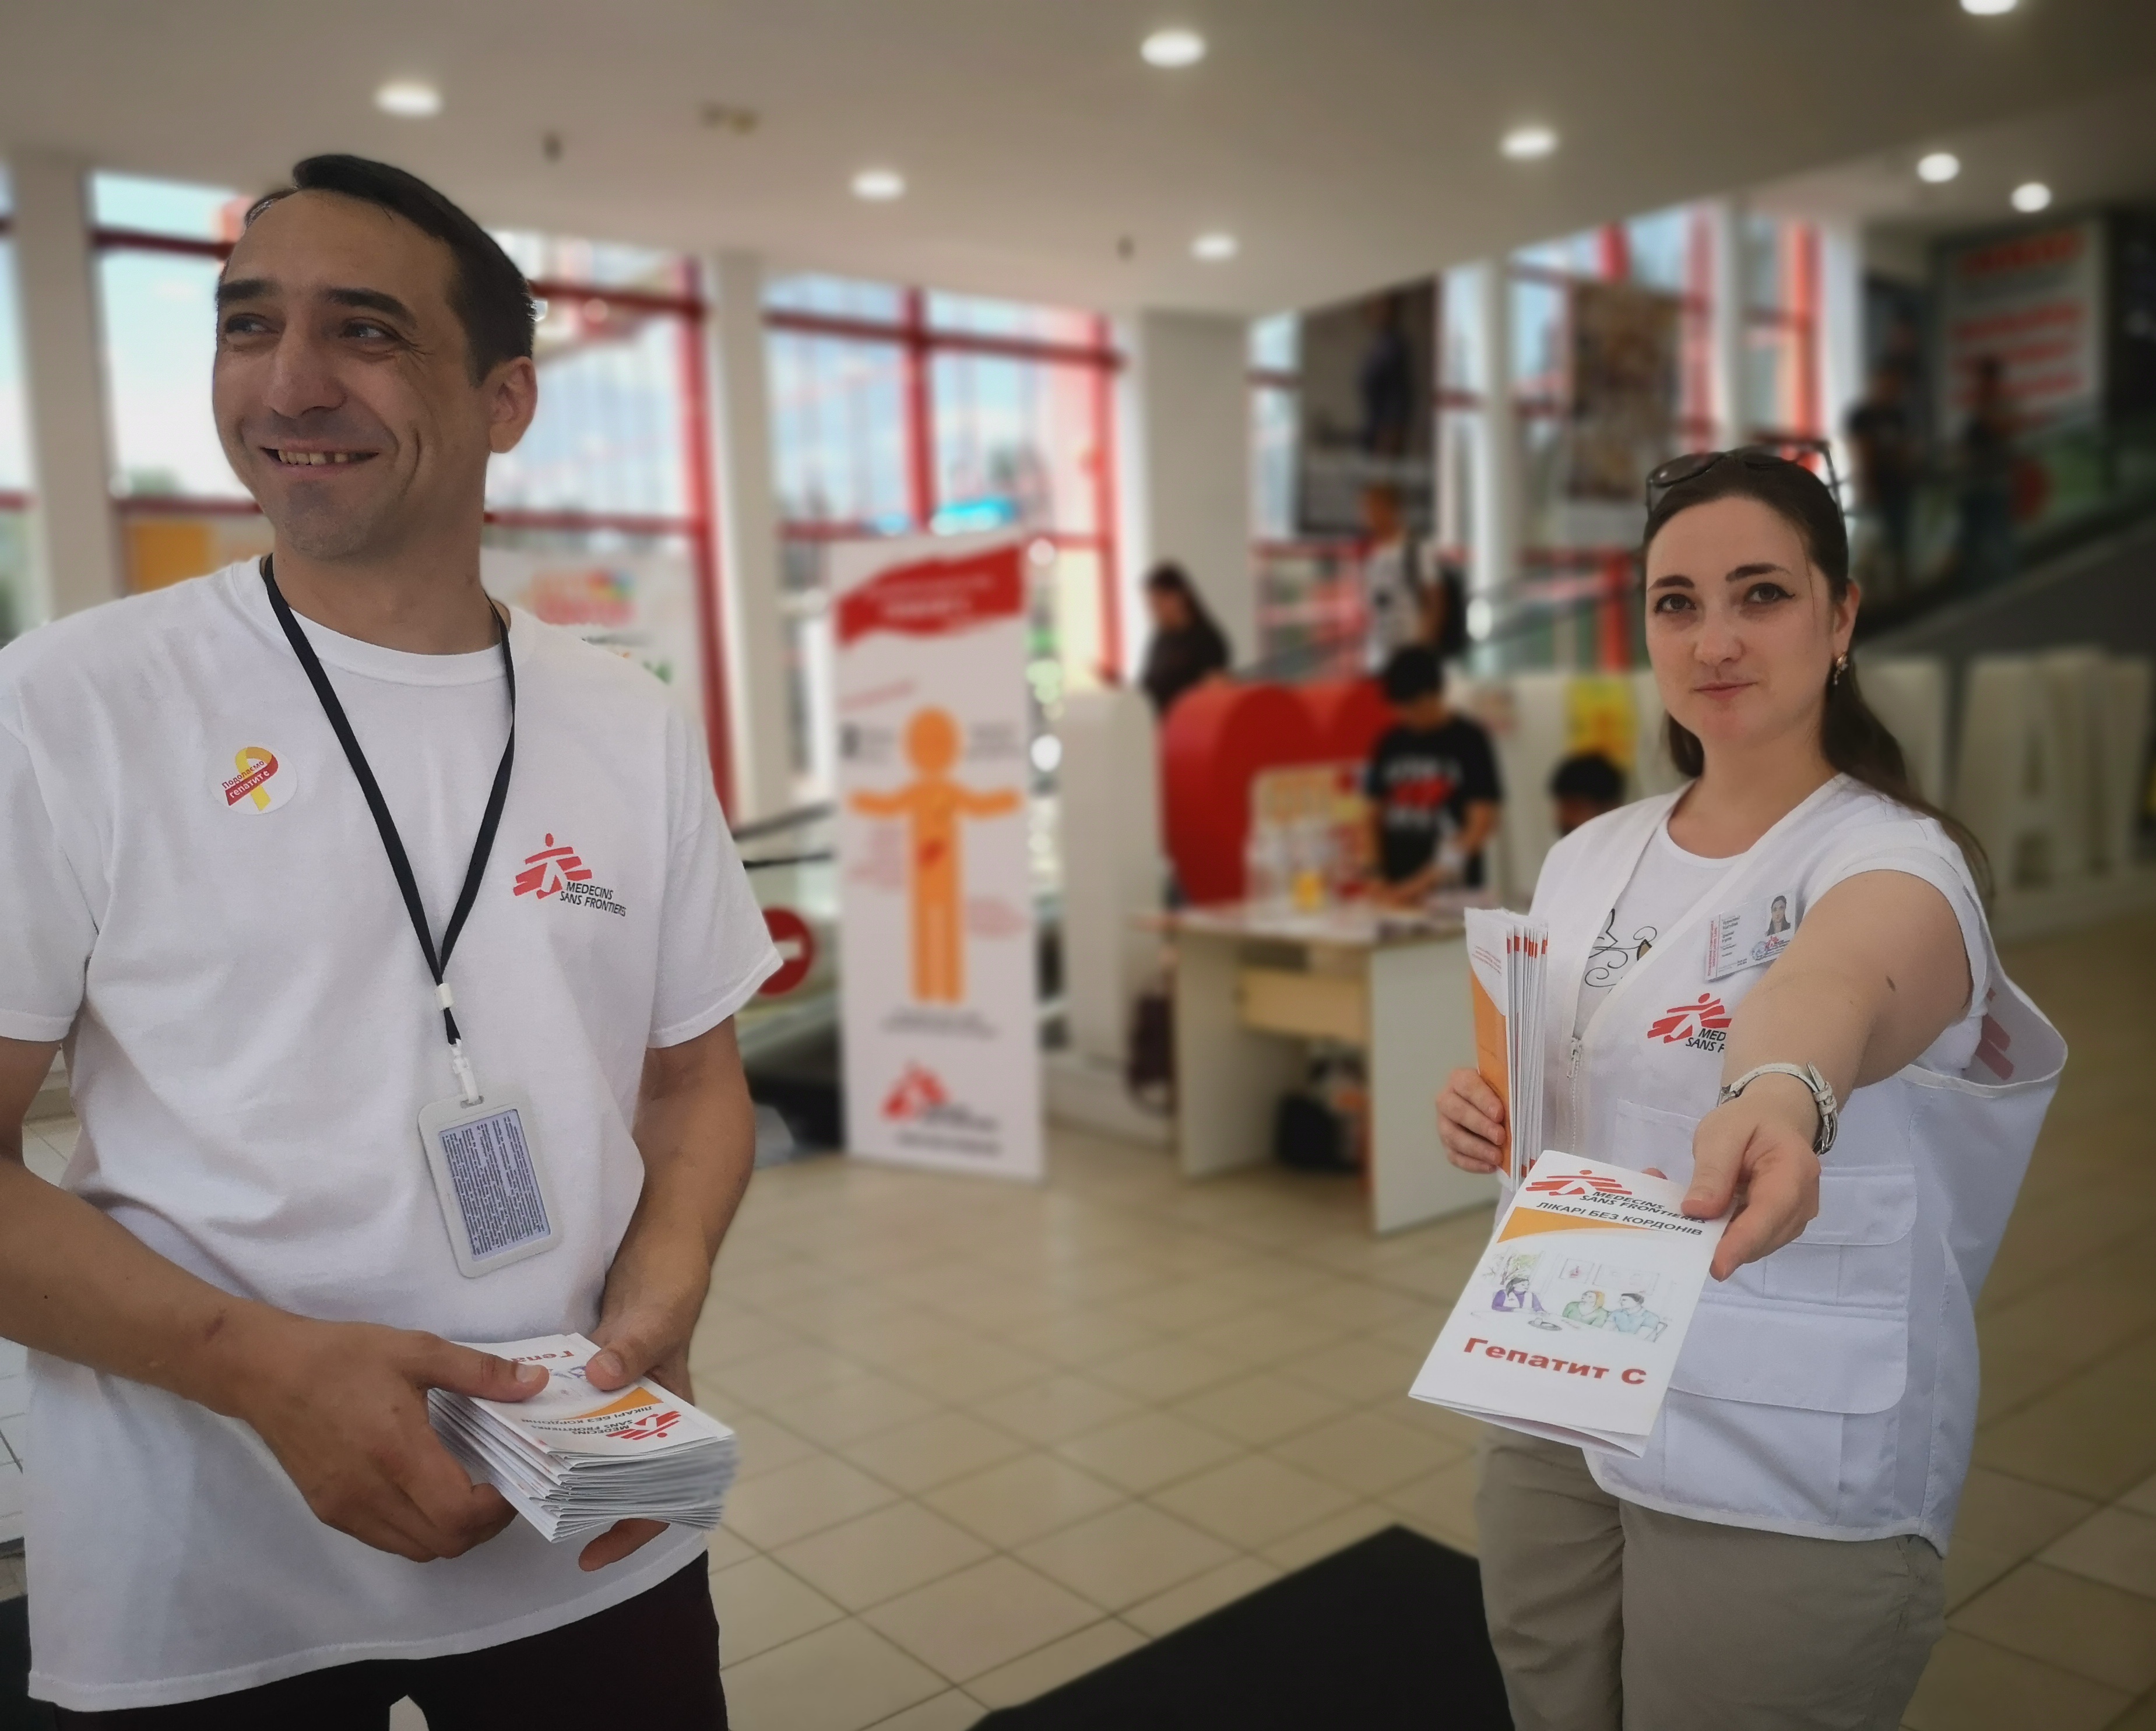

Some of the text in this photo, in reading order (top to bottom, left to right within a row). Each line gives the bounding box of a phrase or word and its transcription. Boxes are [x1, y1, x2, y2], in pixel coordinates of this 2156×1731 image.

[222, 761, 265, 789] Подолаємо
[229, 773, 263, 798] гепатит
[567, 881, 614, 900] MEDECINS
[560, 891, 582, 905] SANS
[1698, 1028, 1727, 1042] MED
[1685, 1037, 1717, 1051] SANS
[1579, 1195, 1617, 1205] SANS
[1592, 1191, 1665, 1209] MEDECINS
[1536, 1202, 1703, 1236] ЛІКАРІ БЕЗ КОРДОНІВ
[511, 1350, 575, 1363] Гепа
[1464, 1337, 1647, 1385] Гепатит С
[614, 1406, 653, 1419] ЛІКАРІ
[572, 1425, 629, 1435] MEDECINS
[604, 1419, 633, 1429] SANS
